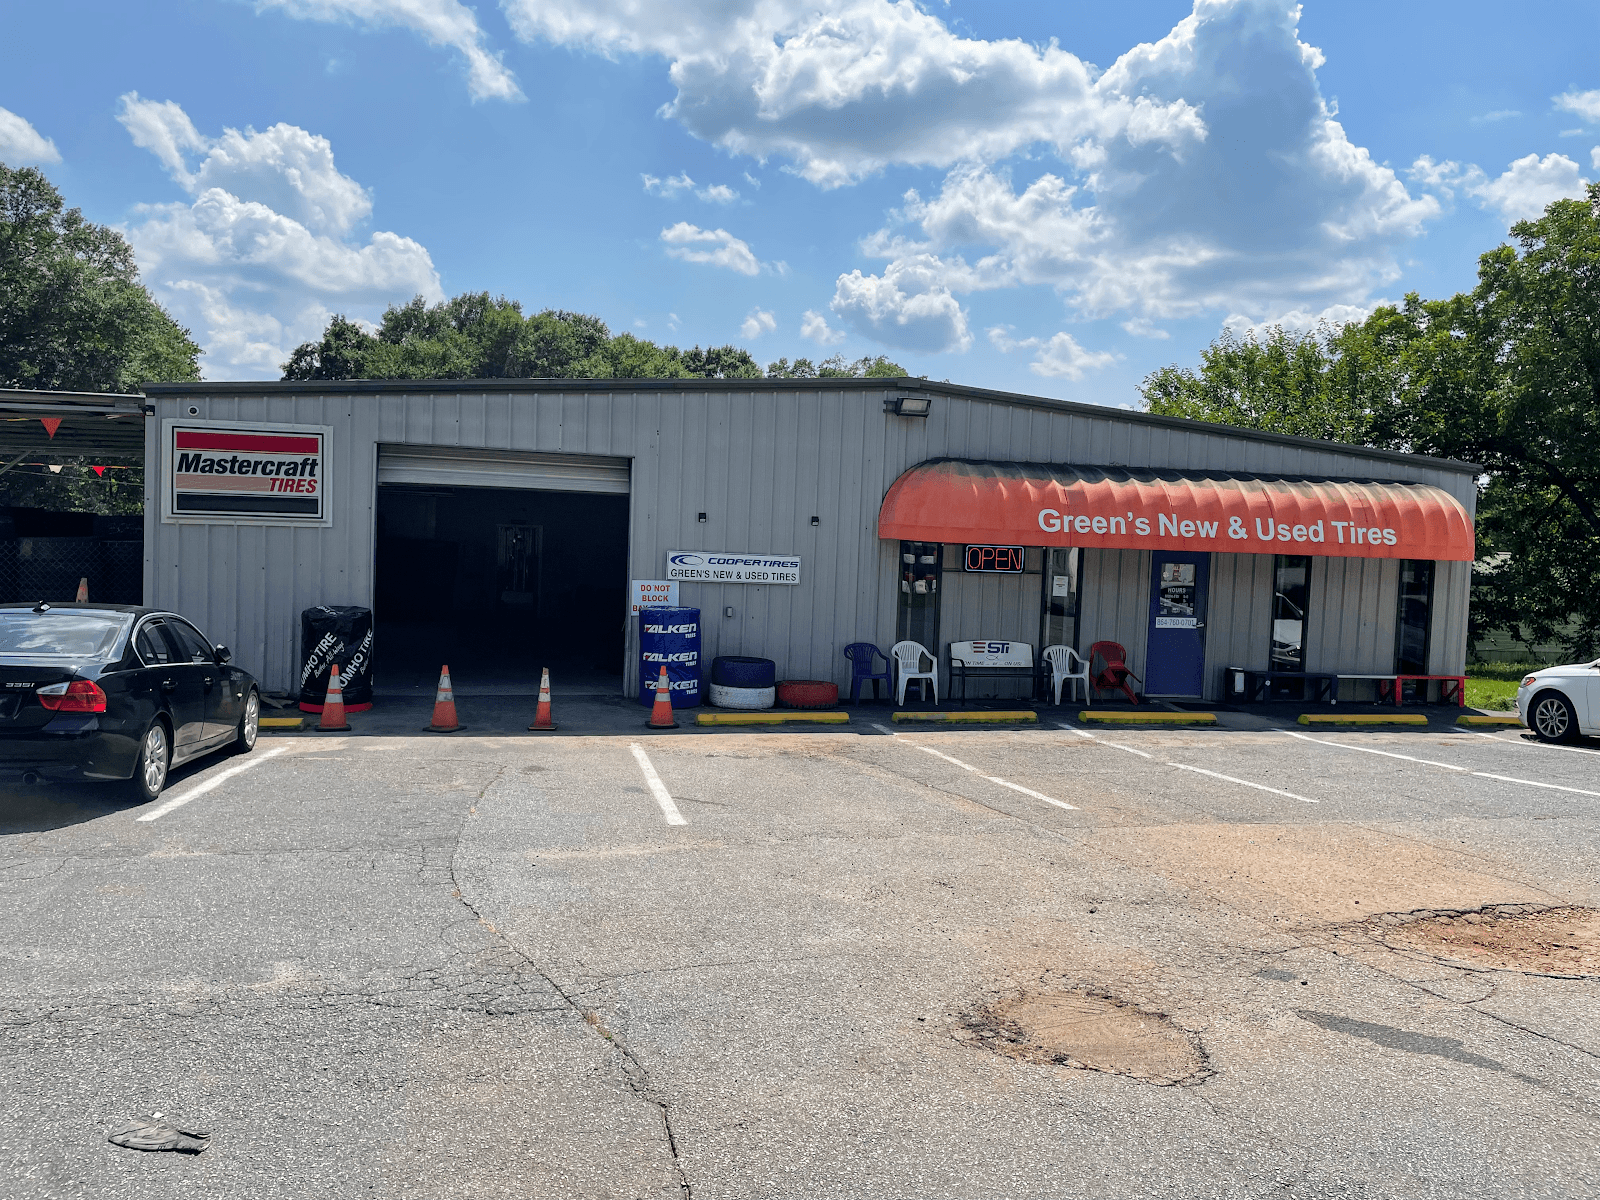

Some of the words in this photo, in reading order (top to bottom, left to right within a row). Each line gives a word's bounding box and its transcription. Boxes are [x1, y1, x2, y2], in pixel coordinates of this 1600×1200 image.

[176, 452, 318, 477] Mastercraft
[269, 477, 318, 493] TIRES
[1038, 508, 1151, 535] Green's
[1158, 513, 1219, 538] New
[1228, 516, 1248, 540] &
[1255, 517, 1325, 542] Used
[1331, 520, 1397, 546] Tires
[968, 547, 1022, 570] OPEN
[670, 568, 710, 579] GREEN'S
[713, 570, 734, 579] NEW
[736, 571, 742, 580] &
[745, 571, 769, 581] USED
[771, 572, 797, 582] TIRES
[640, 584, 652, 592] DO
[654, 584, 670, 592] NOT
[641, 594, 669, 603] BLOCK
[643, 623, 697, 634] FALKEN
[314, 632, 337, 656] TIRE
[643, 651, 698, 662] FALKEN
[340, 653, 364, 690] UMHO
[645, 679, 698, 690] FAKEN
